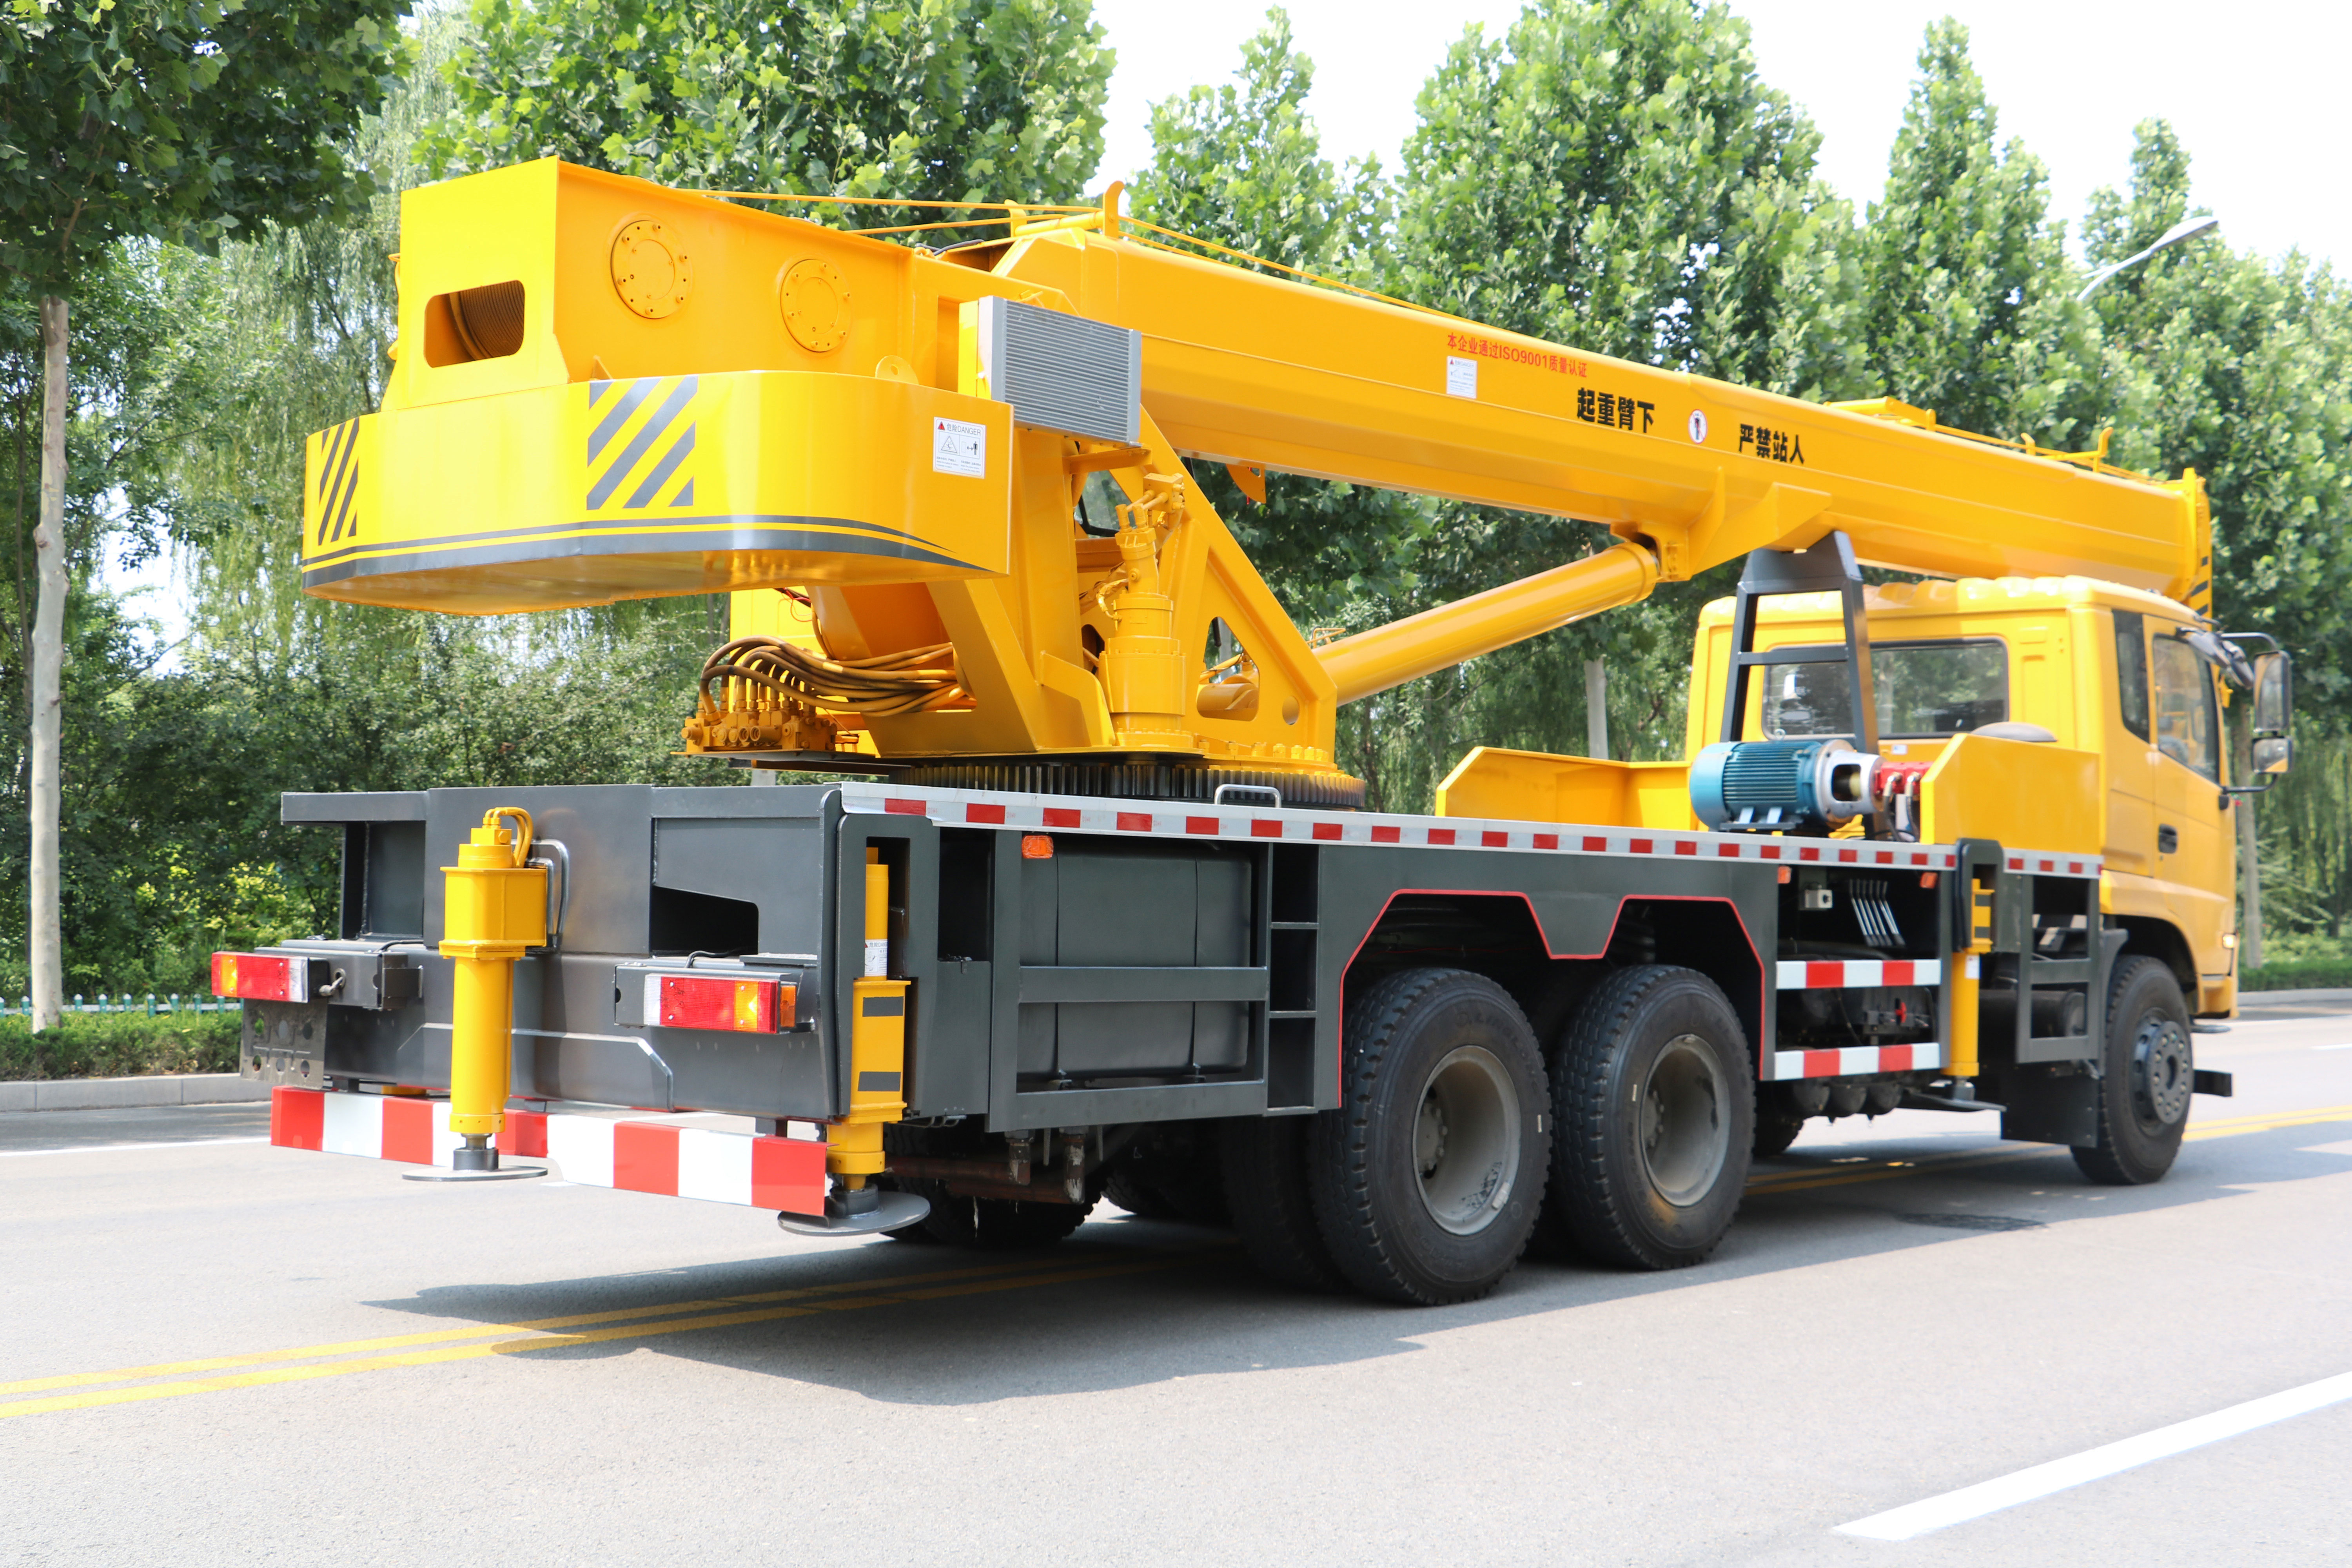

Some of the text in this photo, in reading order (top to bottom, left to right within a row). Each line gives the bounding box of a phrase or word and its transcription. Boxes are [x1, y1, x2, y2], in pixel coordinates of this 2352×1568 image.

[1448, 332, 1587, 377] 本企业通过ISO9001质量认证
[1577, 388, 1804, 463] 起重臂下 严禁站人
